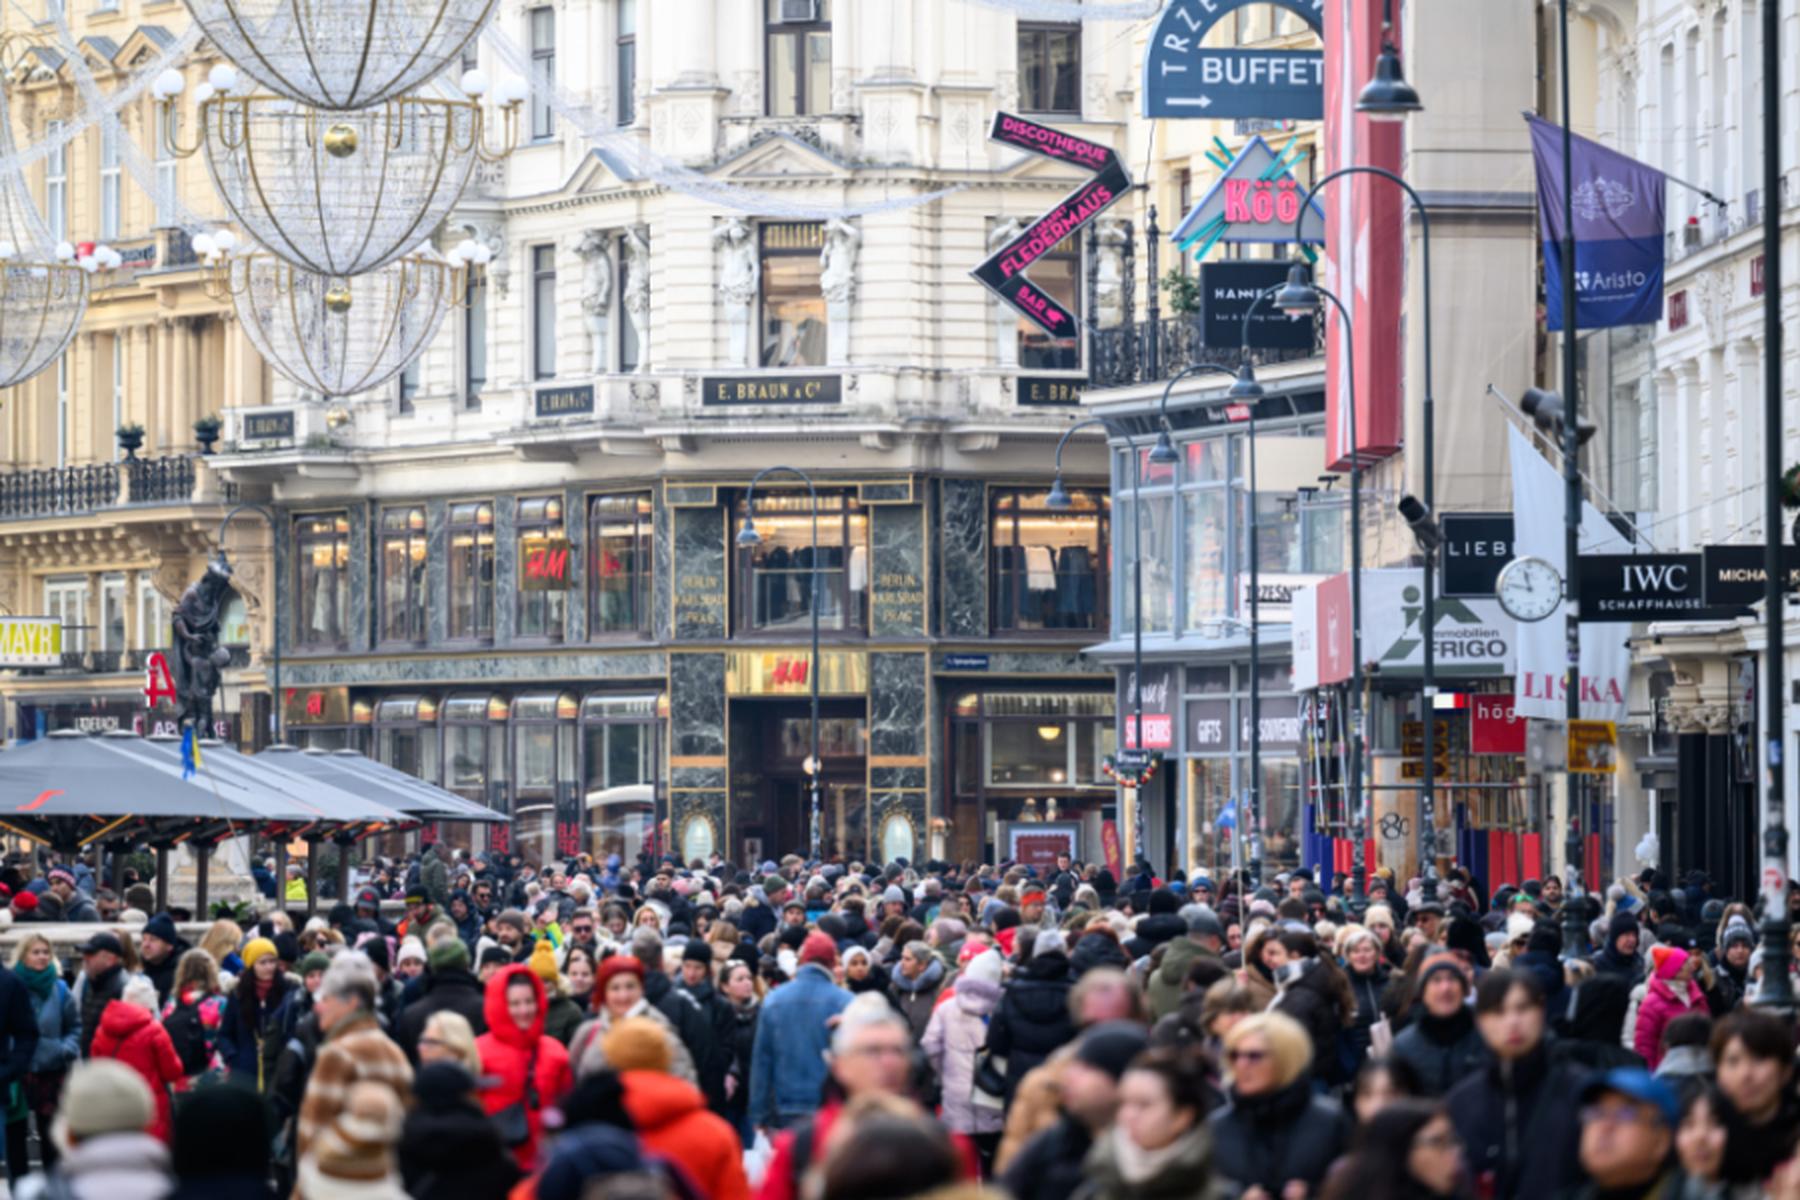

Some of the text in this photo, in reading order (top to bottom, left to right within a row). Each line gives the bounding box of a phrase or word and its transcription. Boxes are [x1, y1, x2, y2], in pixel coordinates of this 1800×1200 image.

[1201, 57, 1324, 85] BUFFET
[1002, 116, 1107, 162] DISCOTHEQUE
[1224, 178, 1300, 224] Köö
[1000, 186, 1113, 278] FLEDERMAUS
[1592, 270, 1647, 290] Aristo
[1017, 285, 1047, 314] BAR
[737, 382, 790, 400] BRAUN
[1049, 383, 1088, 400] BRA
[1448, 541, 1514, 556] LIEB
[1622, 565, 1688, 592] IWC
[1718, 568, 1786, 582] MICHA
[1599, 600, 1712, 611] SCHAFFHAUSE
[1434, 627, 1500, 639] mmobilien
[1477, 704, 1526, 724] hög
